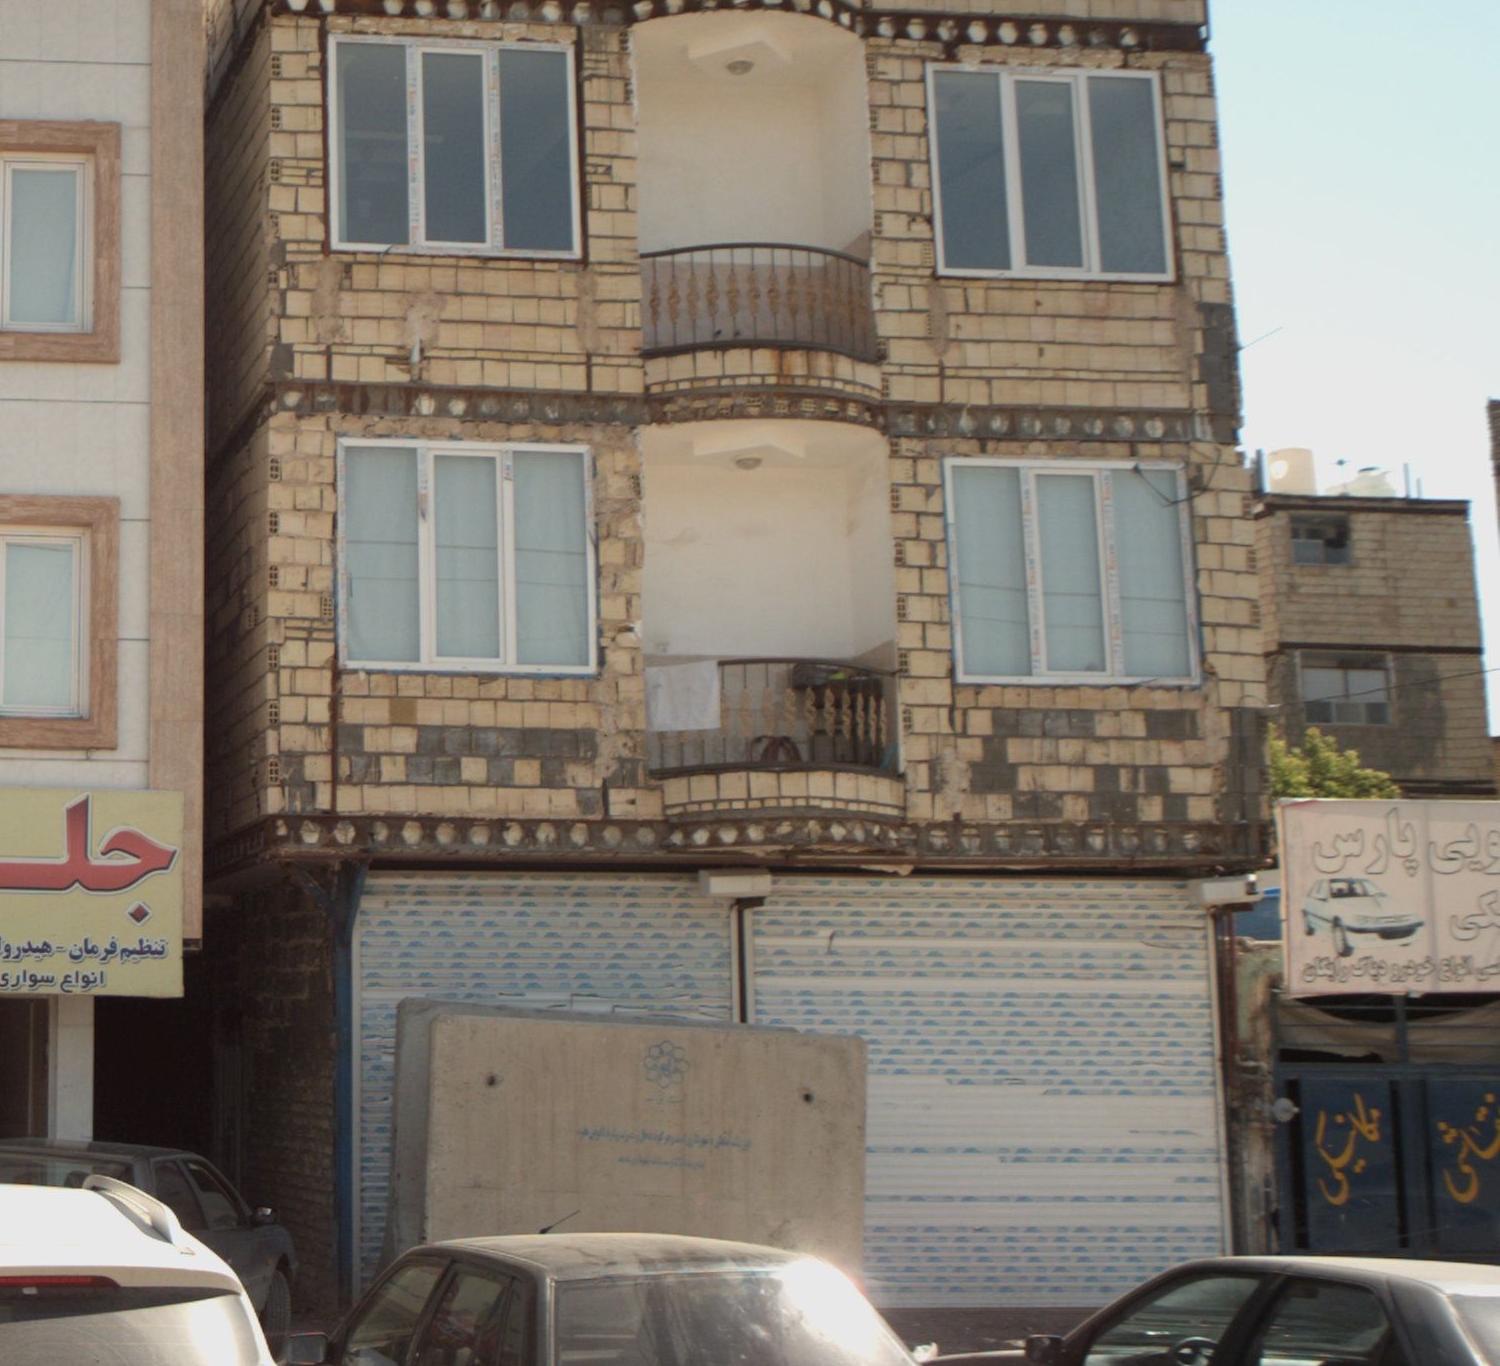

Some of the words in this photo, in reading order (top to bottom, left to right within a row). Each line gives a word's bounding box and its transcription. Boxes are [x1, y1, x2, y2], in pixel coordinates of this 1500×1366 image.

[1313, 807, 1419, 877] پارس
[69, 937, 118, 961] فرمان
[121, 937, 166, 961] تنظیم
[61, 971, 104, 993] انواع
